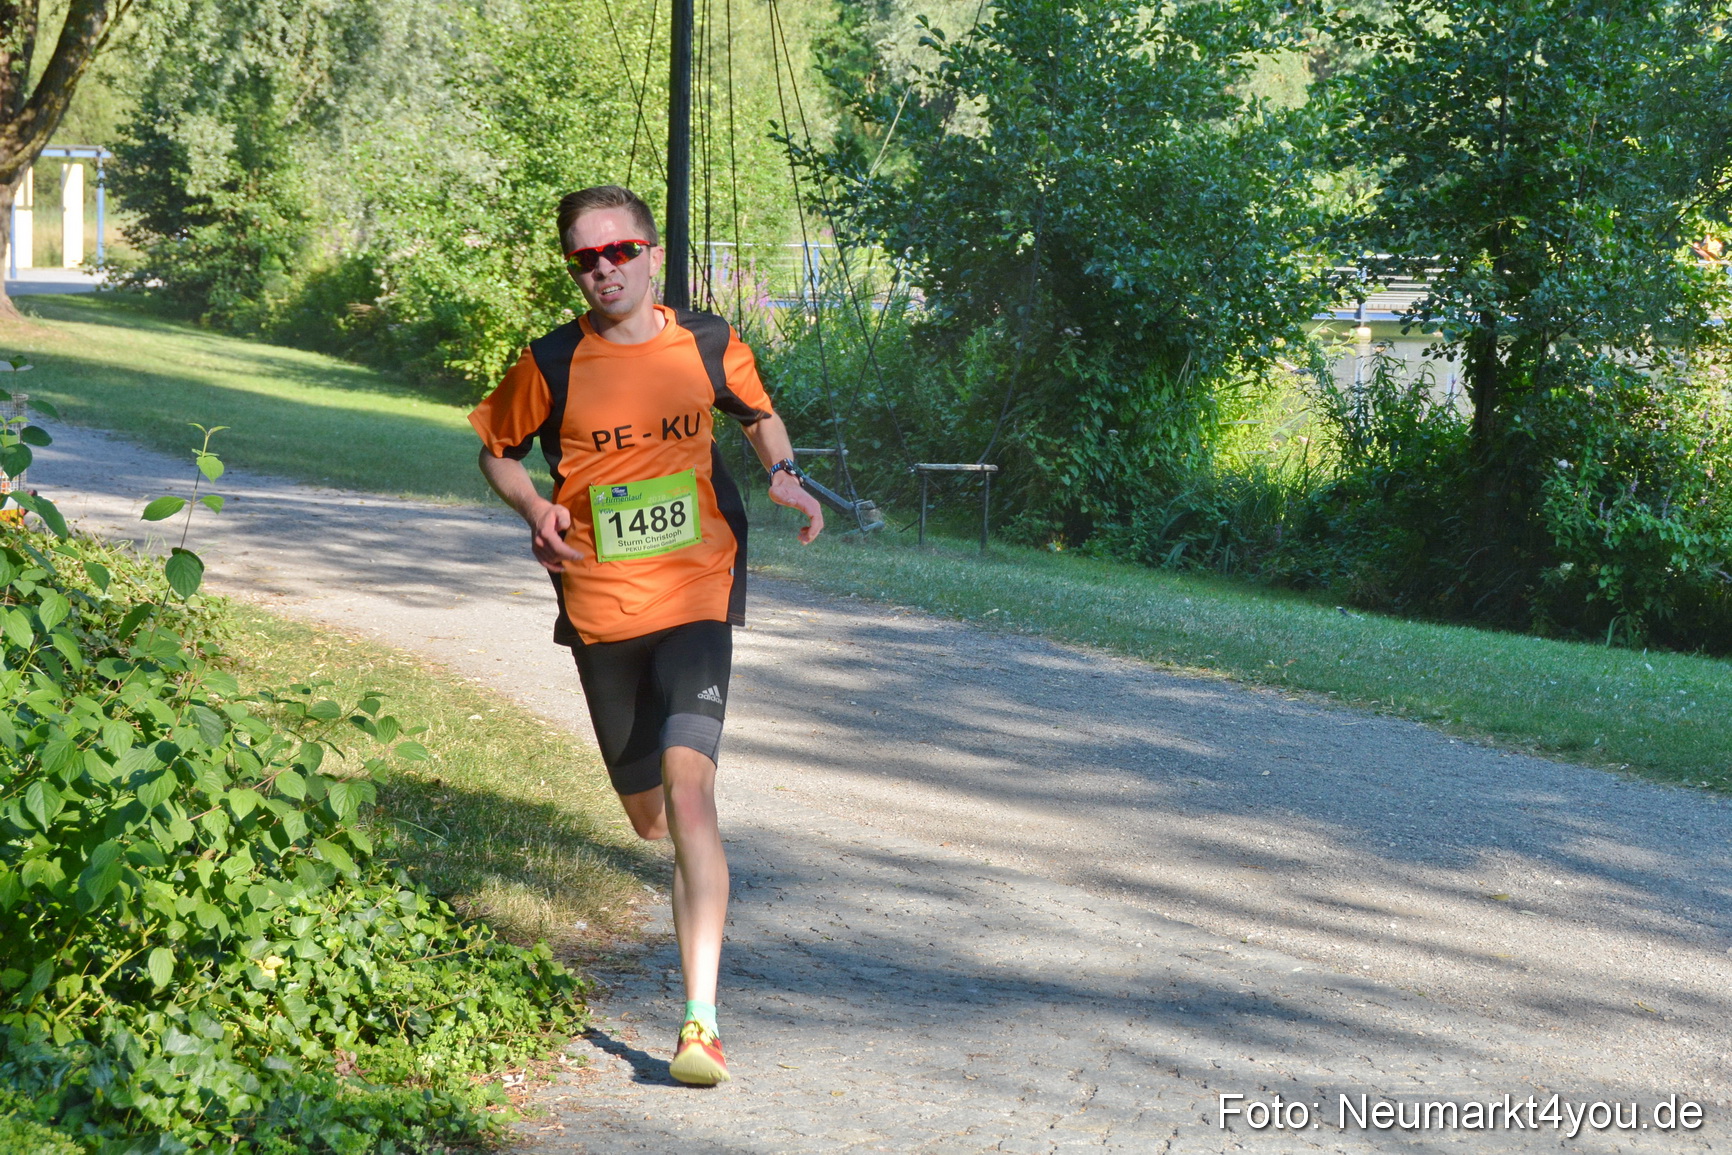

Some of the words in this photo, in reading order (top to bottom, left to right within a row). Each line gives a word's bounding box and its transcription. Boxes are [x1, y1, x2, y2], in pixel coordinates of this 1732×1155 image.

[592, 425, 635, 452] PE
[662, 412, 700, 440] KU
[608, 501, 686, 538] 1488
[618, 539, 643, 547] Sturm
[645, 529, 682, 544] Christoph
[661, 538, 677, 546] GmbH
